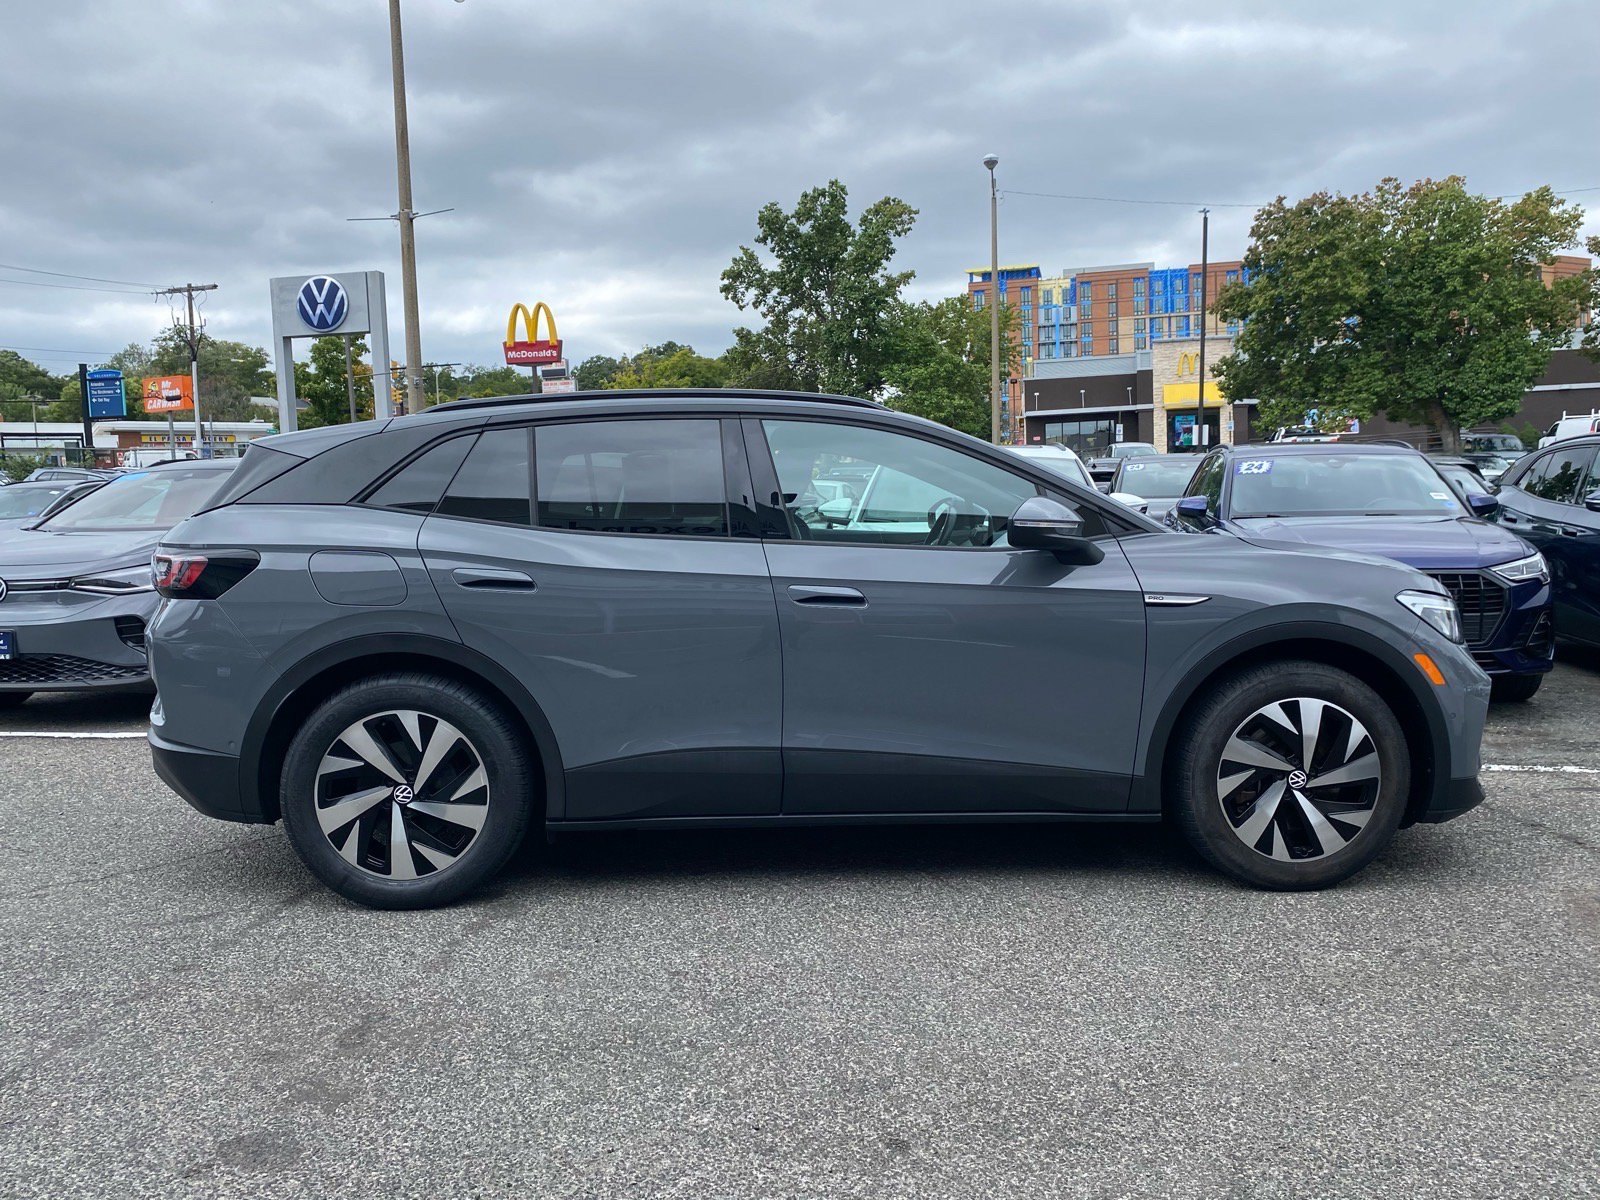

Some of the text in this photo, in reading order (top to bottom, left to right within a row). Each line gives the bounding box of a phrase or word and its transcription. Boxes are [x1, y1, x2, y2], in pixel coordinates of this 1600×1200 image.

[507, 349, 557, 359] McDonald's
[161, 380, 172, 389] Mr
[161, 388, 181, 396] Wash
[161, 434, 187, 442] PASA
[190, 434, 229, 442] GOCERY
[1244, 463, 1264, 471] 24
